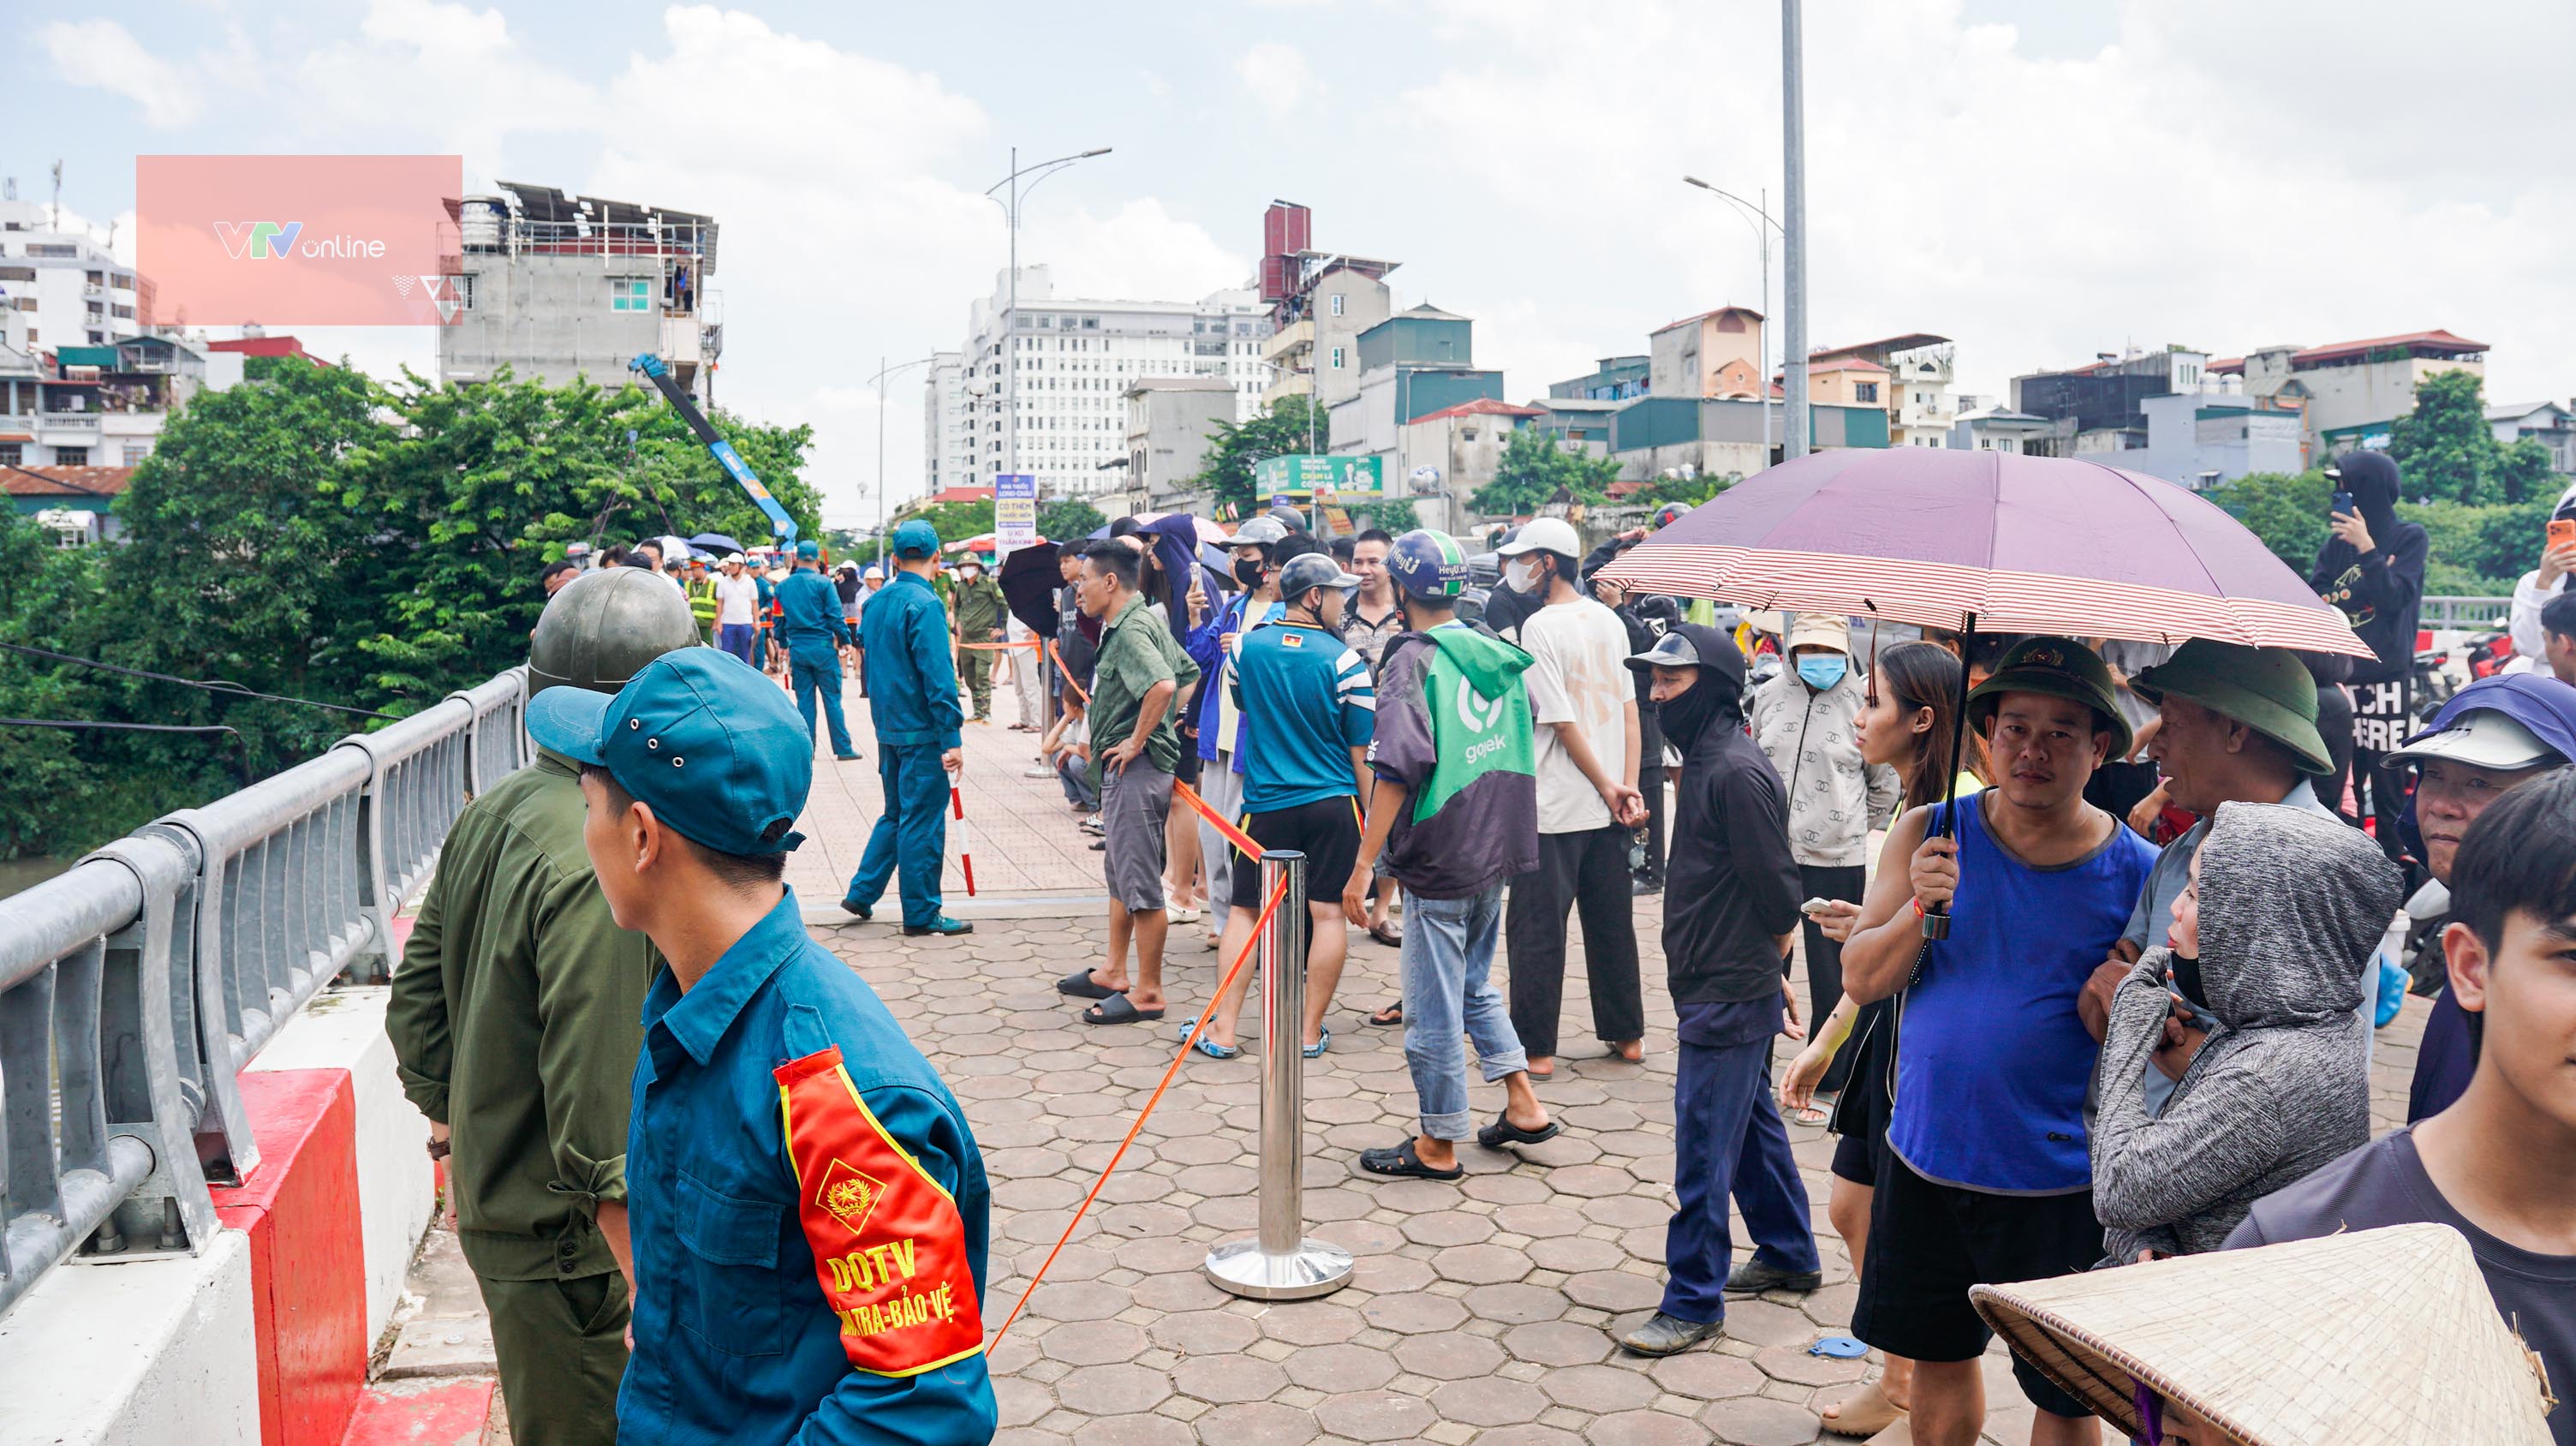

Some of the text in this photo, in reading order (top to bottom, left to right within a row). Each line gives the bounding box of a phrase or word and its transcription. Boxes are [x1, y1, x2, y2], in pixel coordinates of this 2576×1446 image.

[1466, 734, 1506, 764] gojek
[826, 1238, 915, 1293] DQTV
[929, 1281, 955, 1324] VỆ
